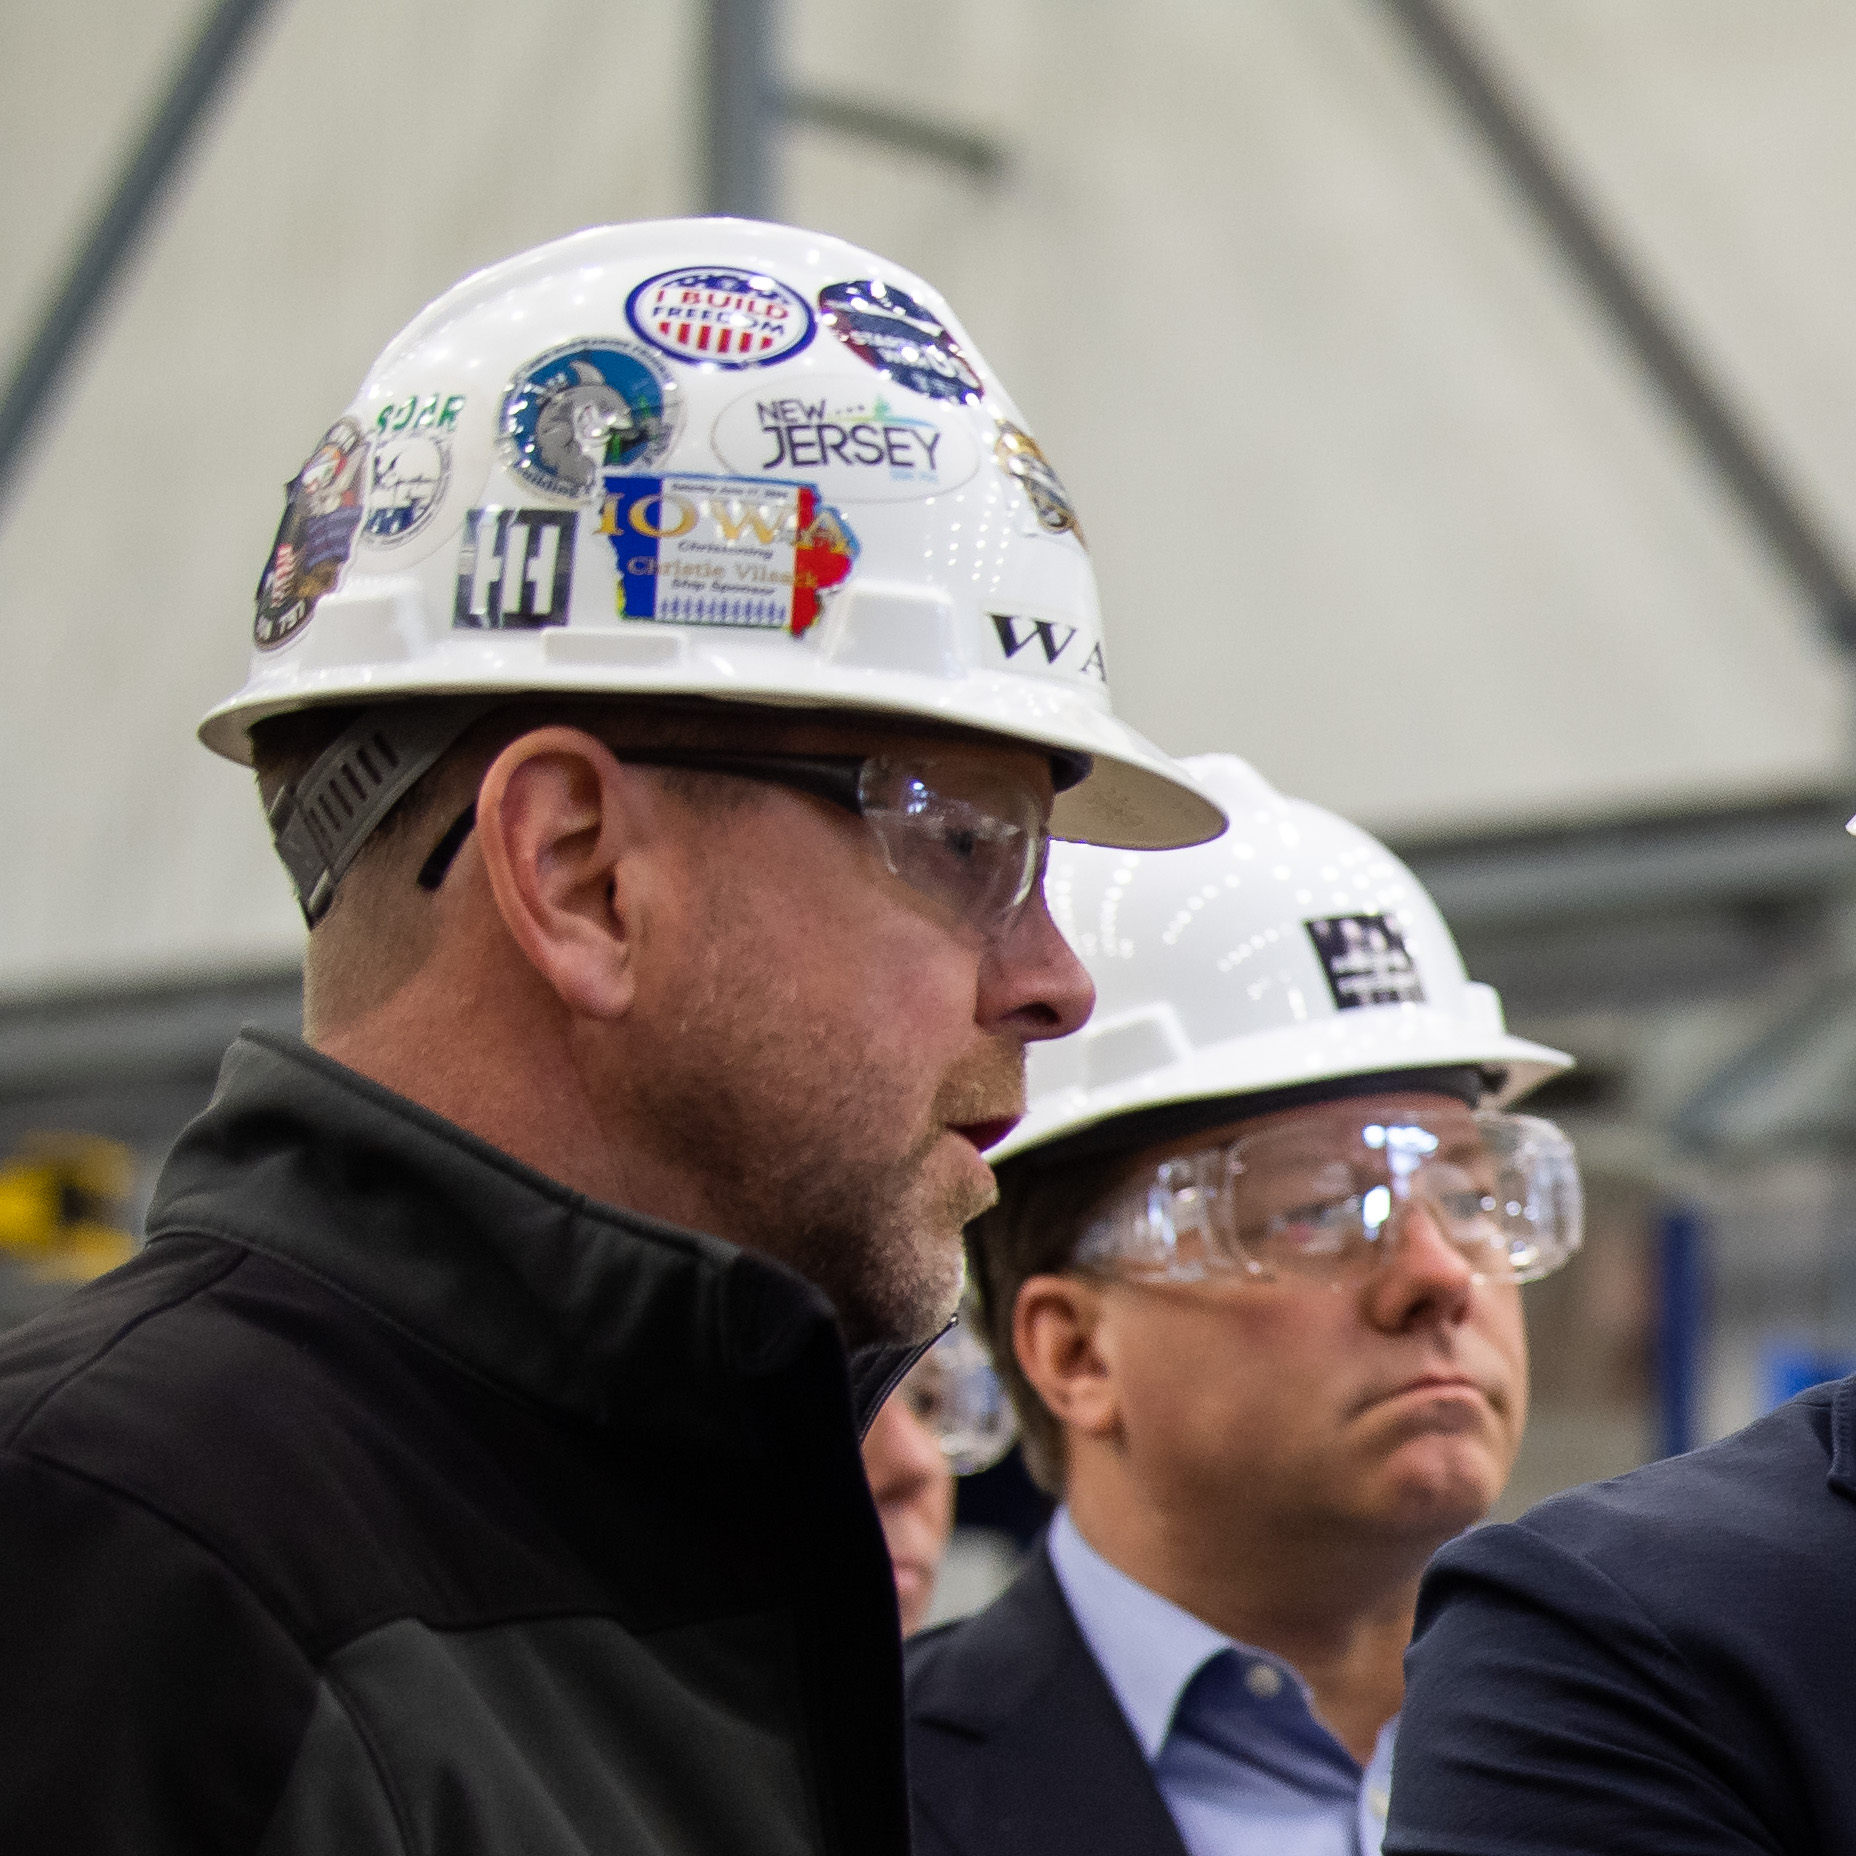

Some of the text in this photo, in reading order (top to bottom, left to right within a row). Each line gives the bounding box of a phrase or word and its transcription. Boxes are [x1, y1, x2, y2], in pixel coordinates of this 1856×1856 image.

[681, 291, 789, 321] BUILD
[756, 398, 826, 424] NEW
[762, 424, 941, 470] JERSEY
[591, 493, 854, 556] IOWA
